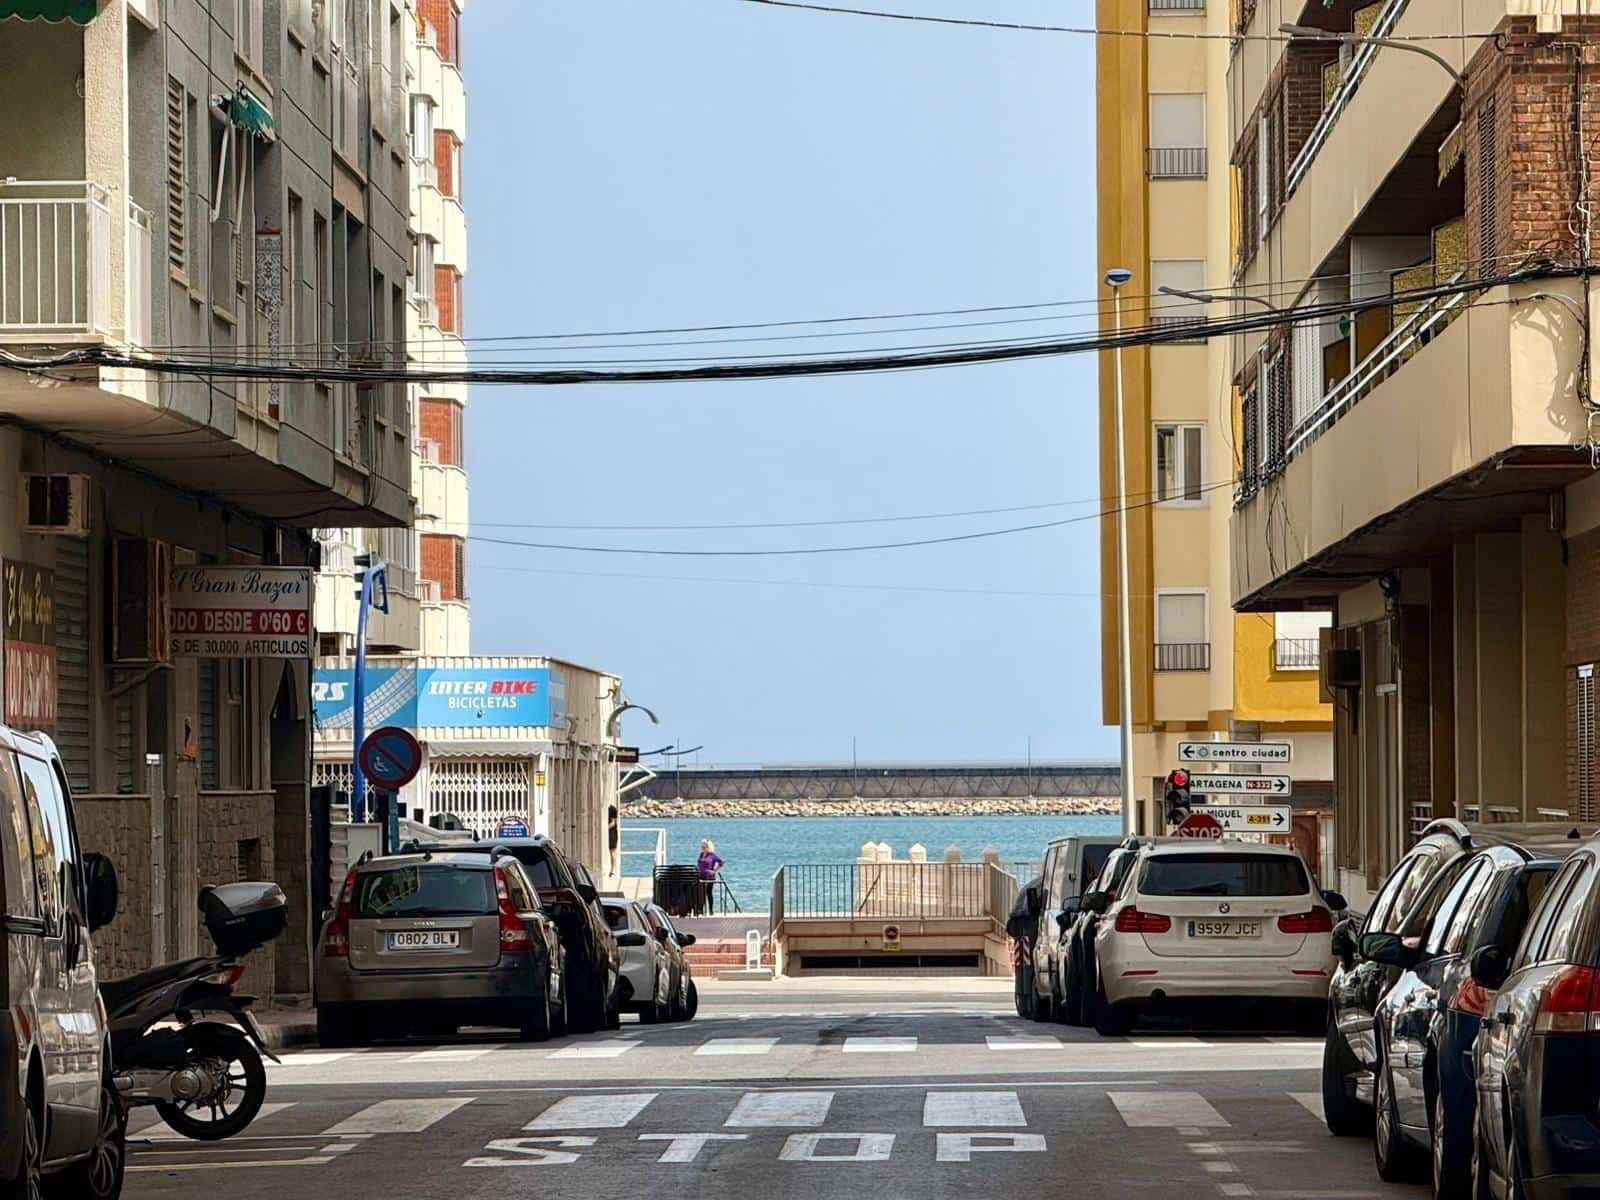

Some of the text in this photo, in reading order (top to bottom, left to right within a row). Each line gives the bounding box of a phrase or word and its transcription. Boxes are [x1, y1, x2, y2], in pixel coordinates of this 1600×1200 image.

[170, 611, 306, 633] ODO DESDE 0'60 €
[185, 640, 199, 653] DE
[245, 640, 307, 655] ARTICULOS
[428, 680, 537, 695] INTER BIKE
[448, 697, 517, 709] BICICLETAS
[1212, 749, 1287, 758] centro ciudad
[1190, 780, 1242, 789] ARTAGENA
[1207, 809, 1242, 818] MIGUEL
[1180, 827, 1221, 838] STOP
[1198, 922, 1258, 935] 9597 JCF
[397, 933, 429, 945] 0802
[462, 1132, 1048, 1167] STOP
